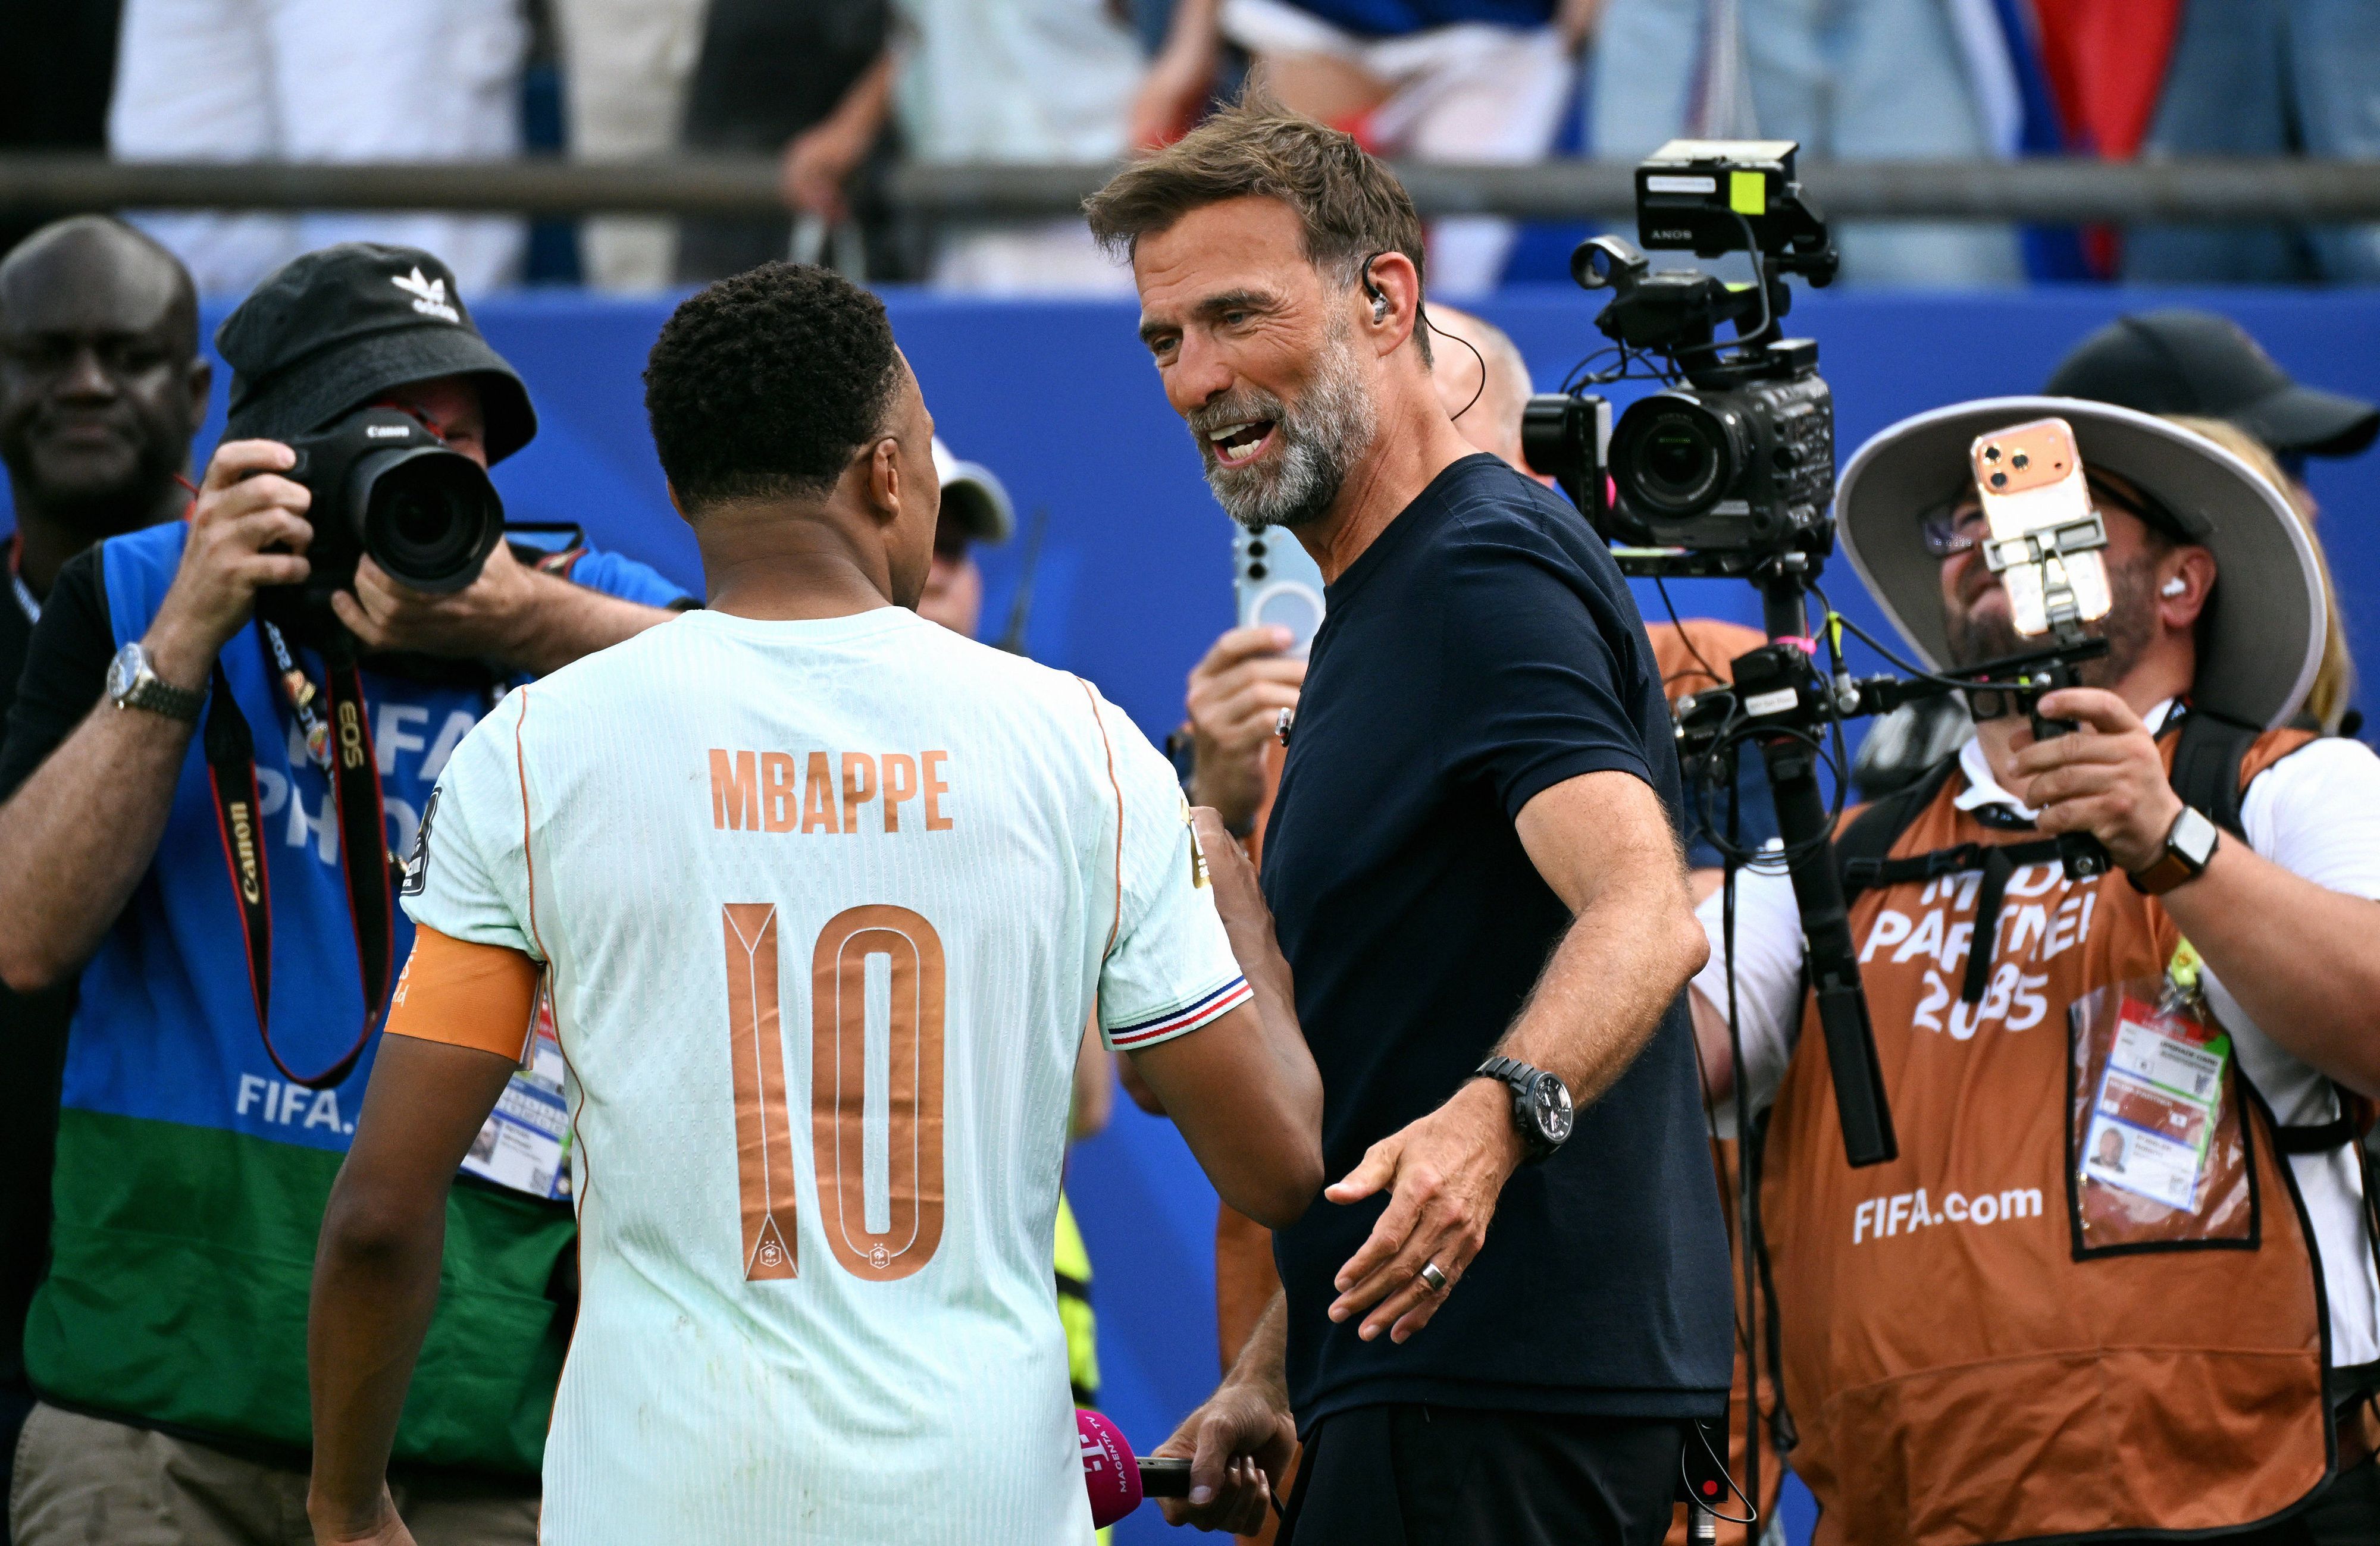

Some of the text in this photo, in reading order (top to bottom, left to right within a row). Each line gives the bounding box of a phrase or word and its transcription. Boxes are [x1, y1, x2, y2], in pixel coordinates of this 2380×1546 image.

[367, 424, 410, 438] Canon
[338, 700, 364, 769] EOS
[708, 748, 953, 834] MBAPPE
[230, 801, 259, 904] Canon
[236, 1073, 358, 1134] FIFA.
[722, 902, 946, 1282] 10
[1853, 1188, 2043, 1245] FIFA.com
